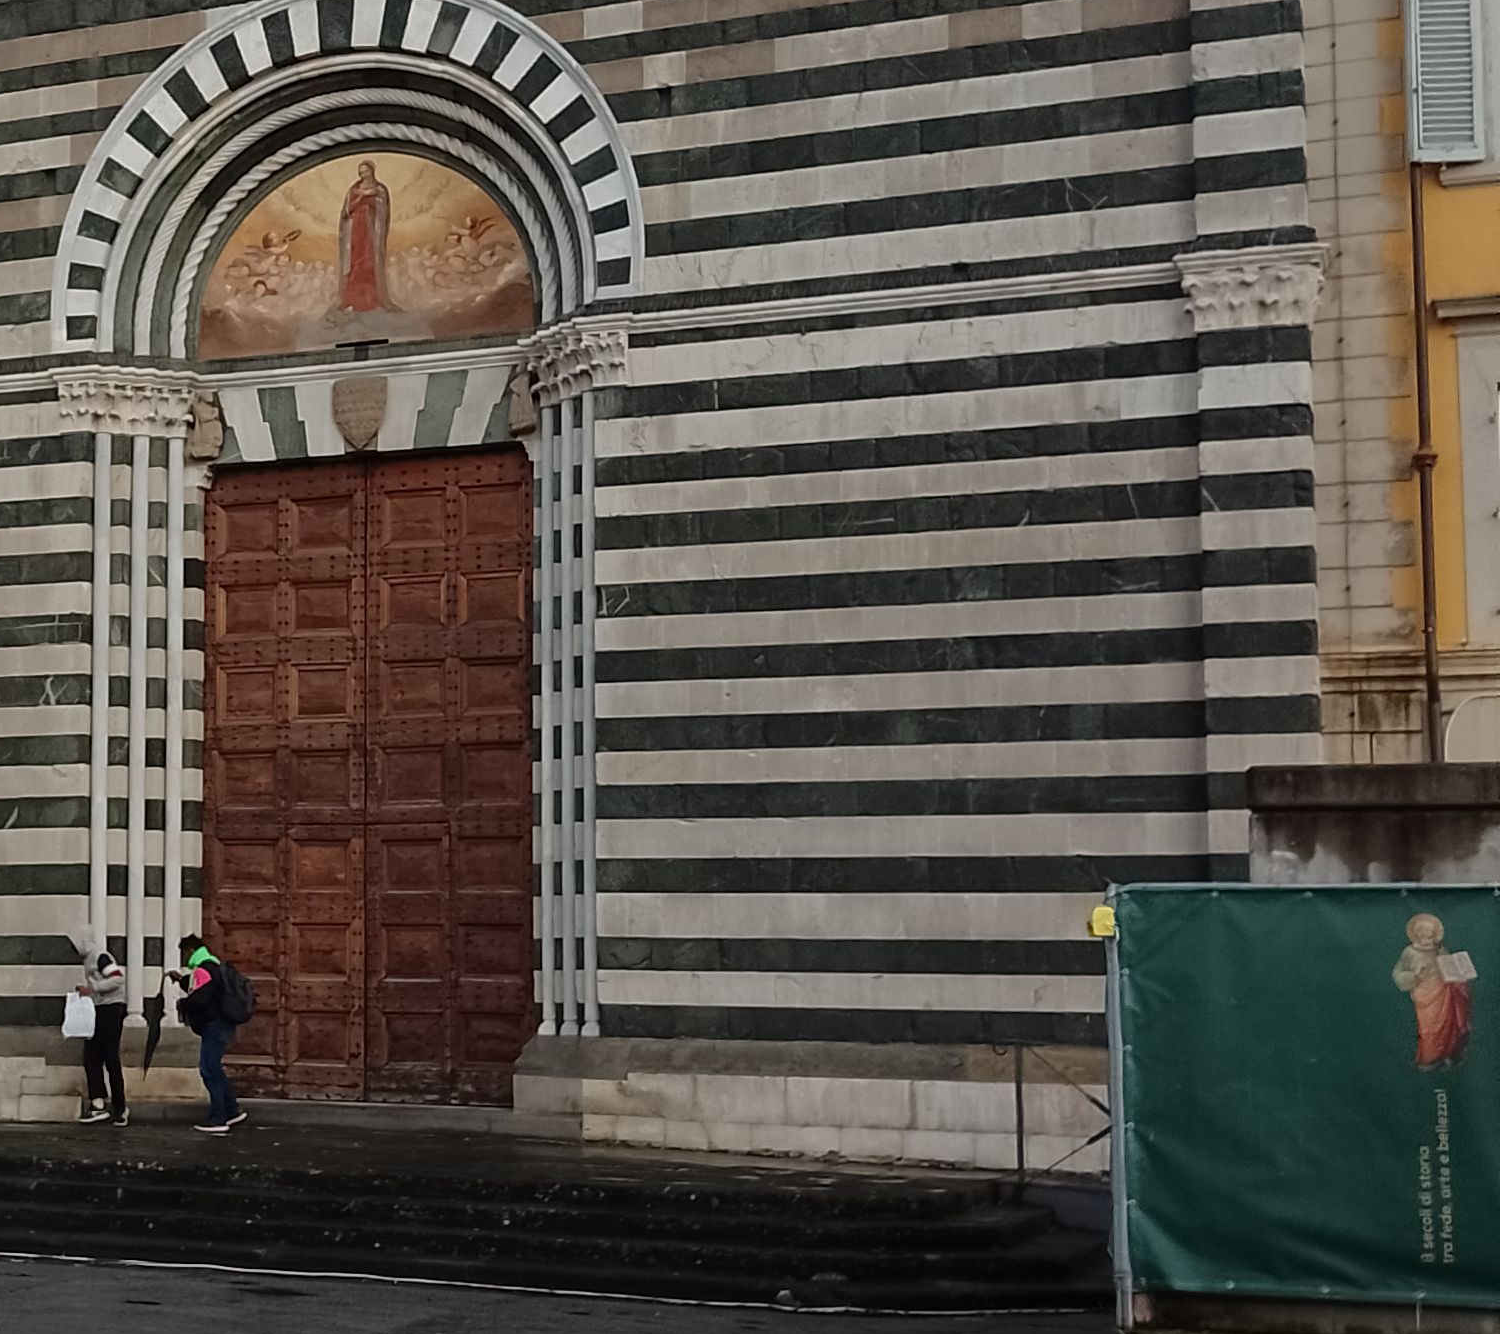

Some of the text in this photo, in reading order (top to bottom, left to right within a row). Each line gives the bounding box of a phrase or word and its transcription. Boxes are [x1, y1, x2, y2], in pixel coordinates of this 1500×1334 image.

[1440, 1154, 1450, 1164] e
[1439, 1167, 1452, 1198] arte
[1418, 1146, 1434, 1263] 8 secoli di storia
[1442, 1242, 1455, 1264] tra
